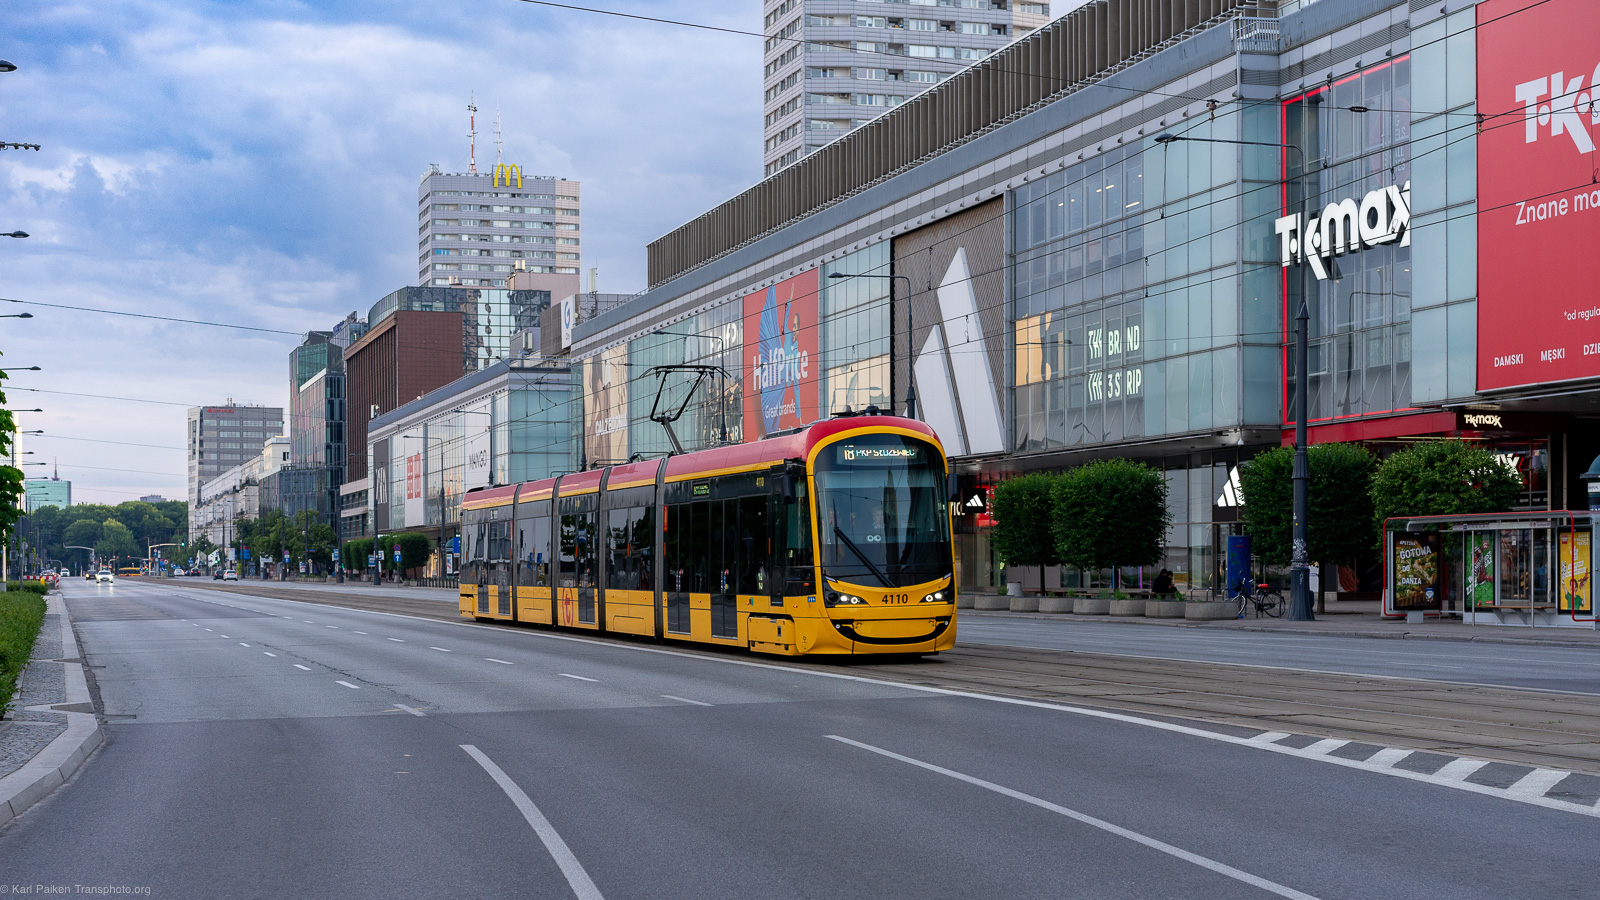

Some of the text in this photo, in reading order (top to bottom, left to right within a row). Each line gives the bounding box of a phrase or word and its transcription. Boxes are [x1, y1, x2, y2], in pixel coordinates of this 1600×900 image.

[1515, 197, 1569, 226] Znane
[1108, 326, 1140, 355] BRND
[1494, 353, 1524, 368] DAMSKI
[1540, 347, 1566, 363] MĘSKI
[753, 346, 809, 391] HalfPrice
[1107, 373, 1113, 399] 3
[779, 399, 796, 416] brands
[1399, 545, 1432, 560] GOTOWA
[1401, 564, 1411, 573] DO
[1401, 577, 1422, 585] DANIA
[881, 593, 909, 605] 4110
